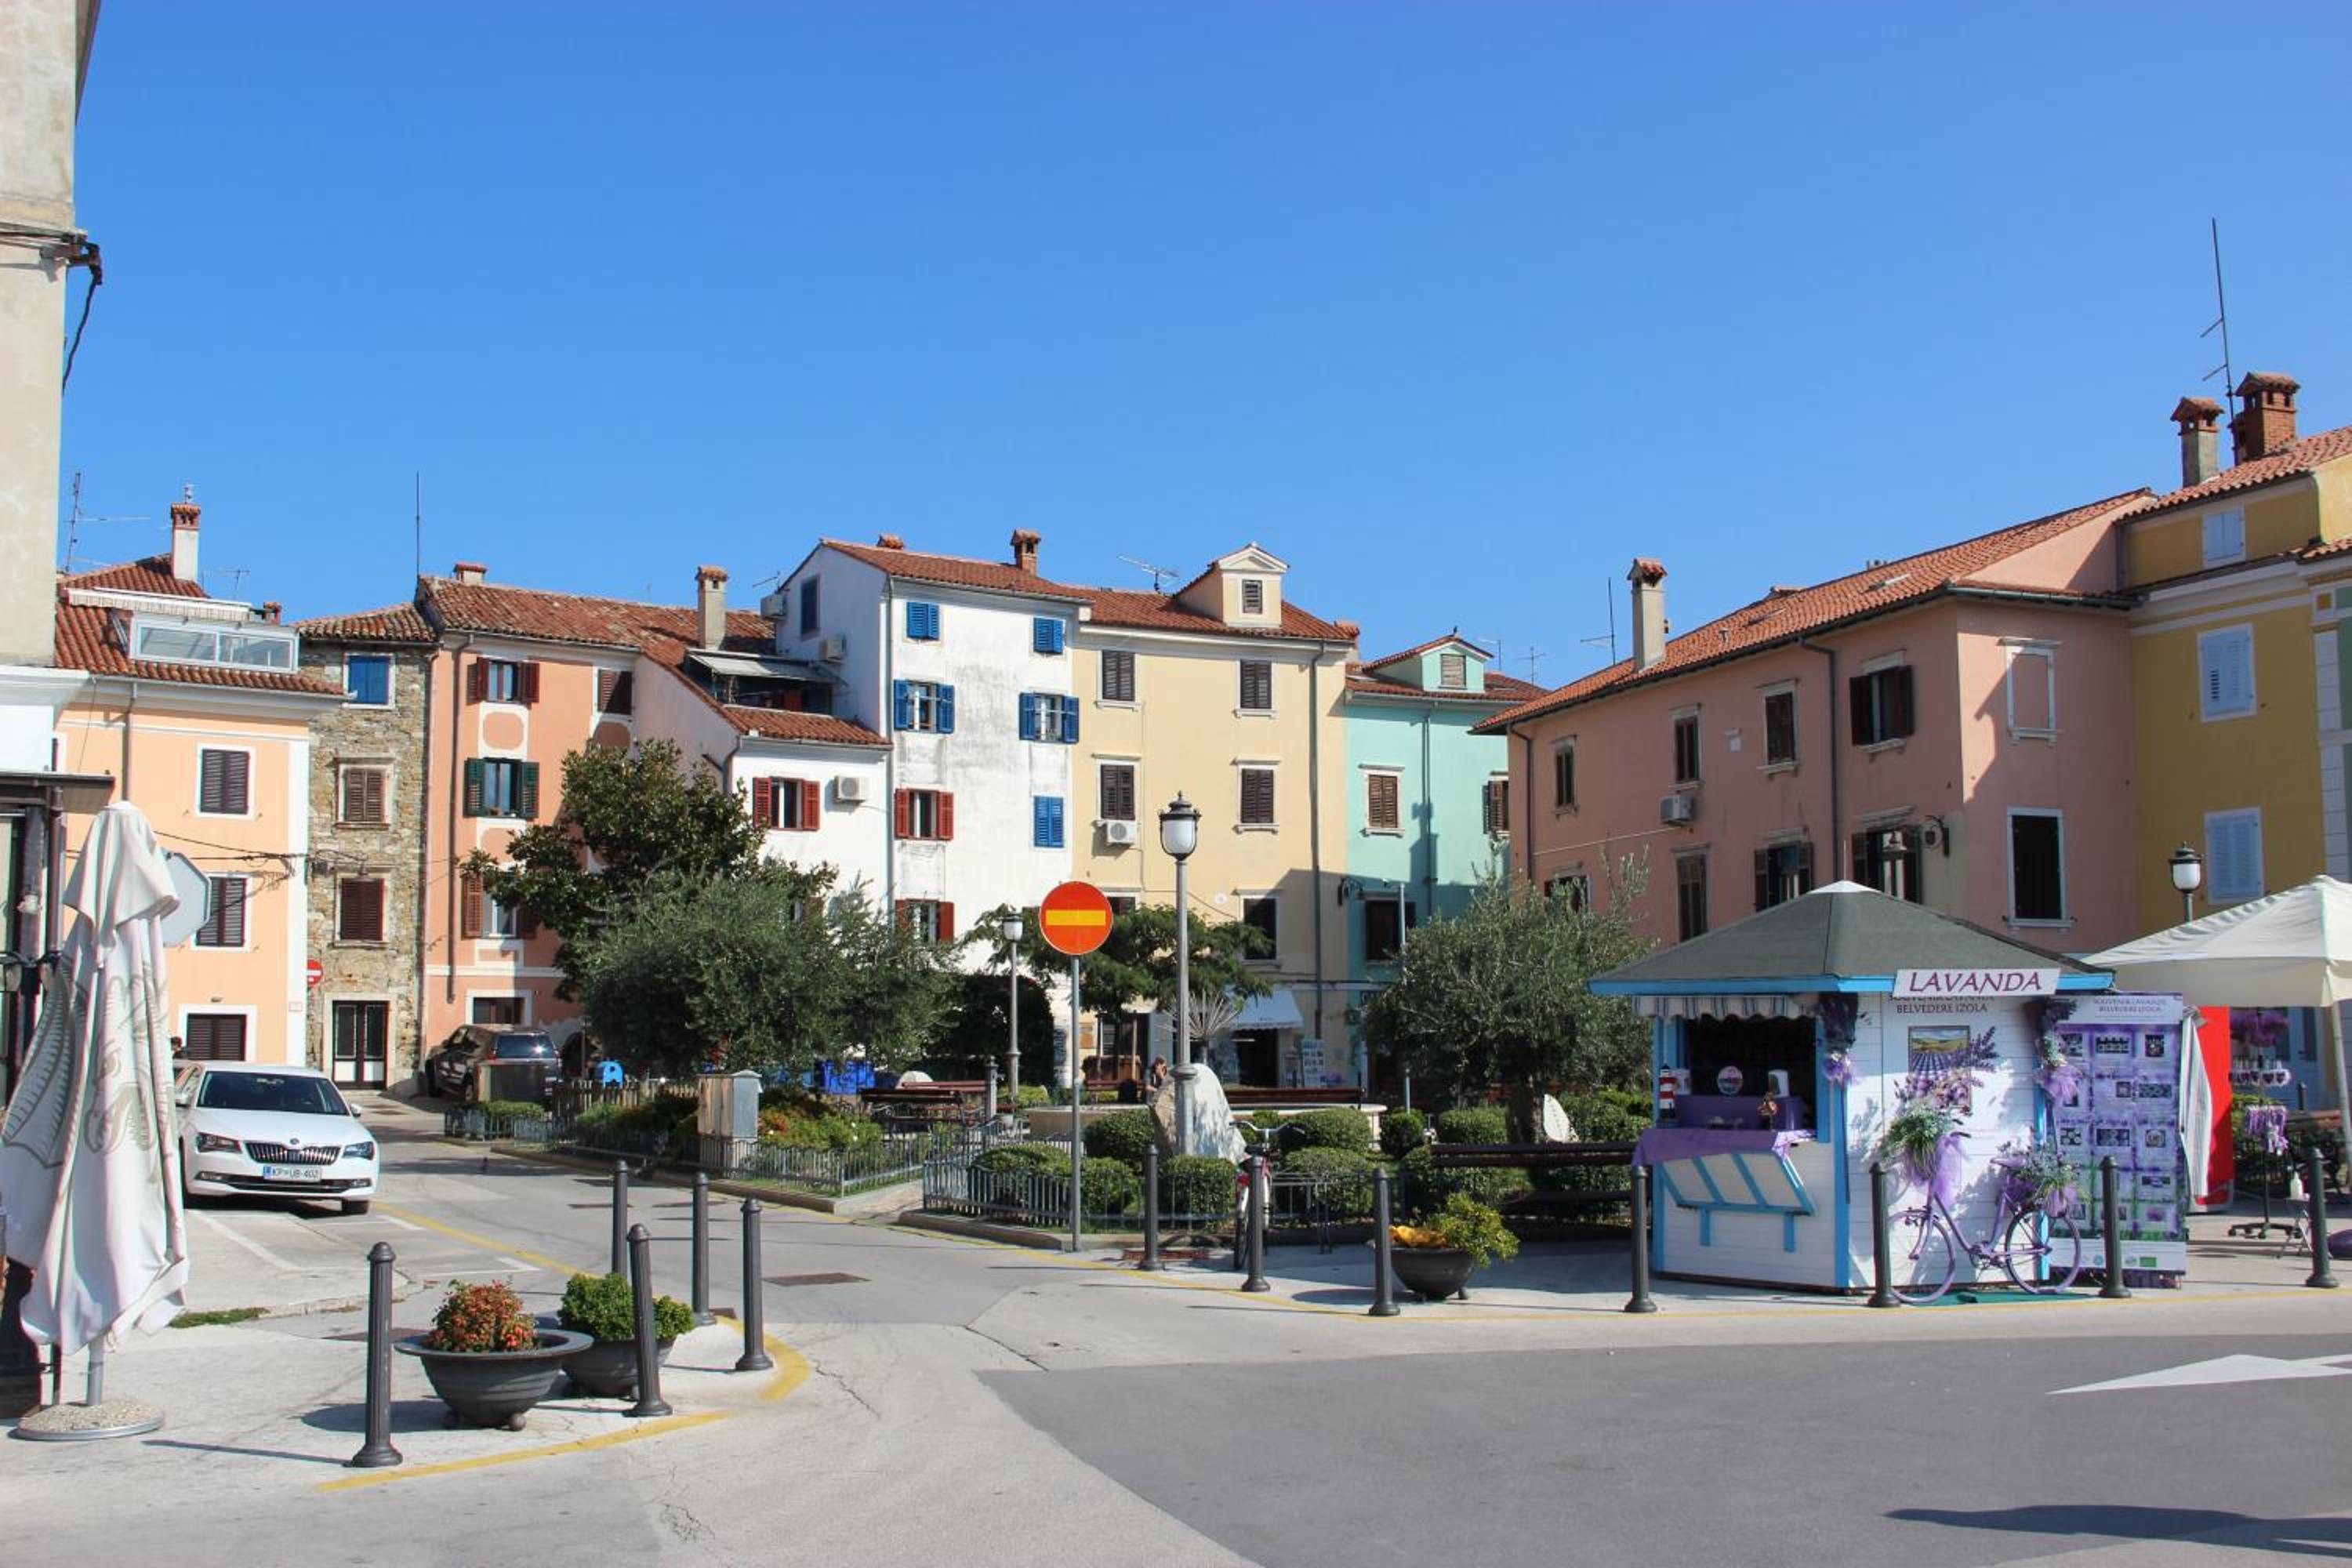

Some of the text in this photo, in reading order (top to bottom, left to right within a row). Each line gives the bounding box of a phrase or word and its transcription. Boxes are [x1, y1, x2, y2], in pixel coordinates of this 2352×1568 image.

[1909, 971, 2042, 994] LAVANDA
[1896, 1003, 1987, 1014] BELVEDERE IZOLA
